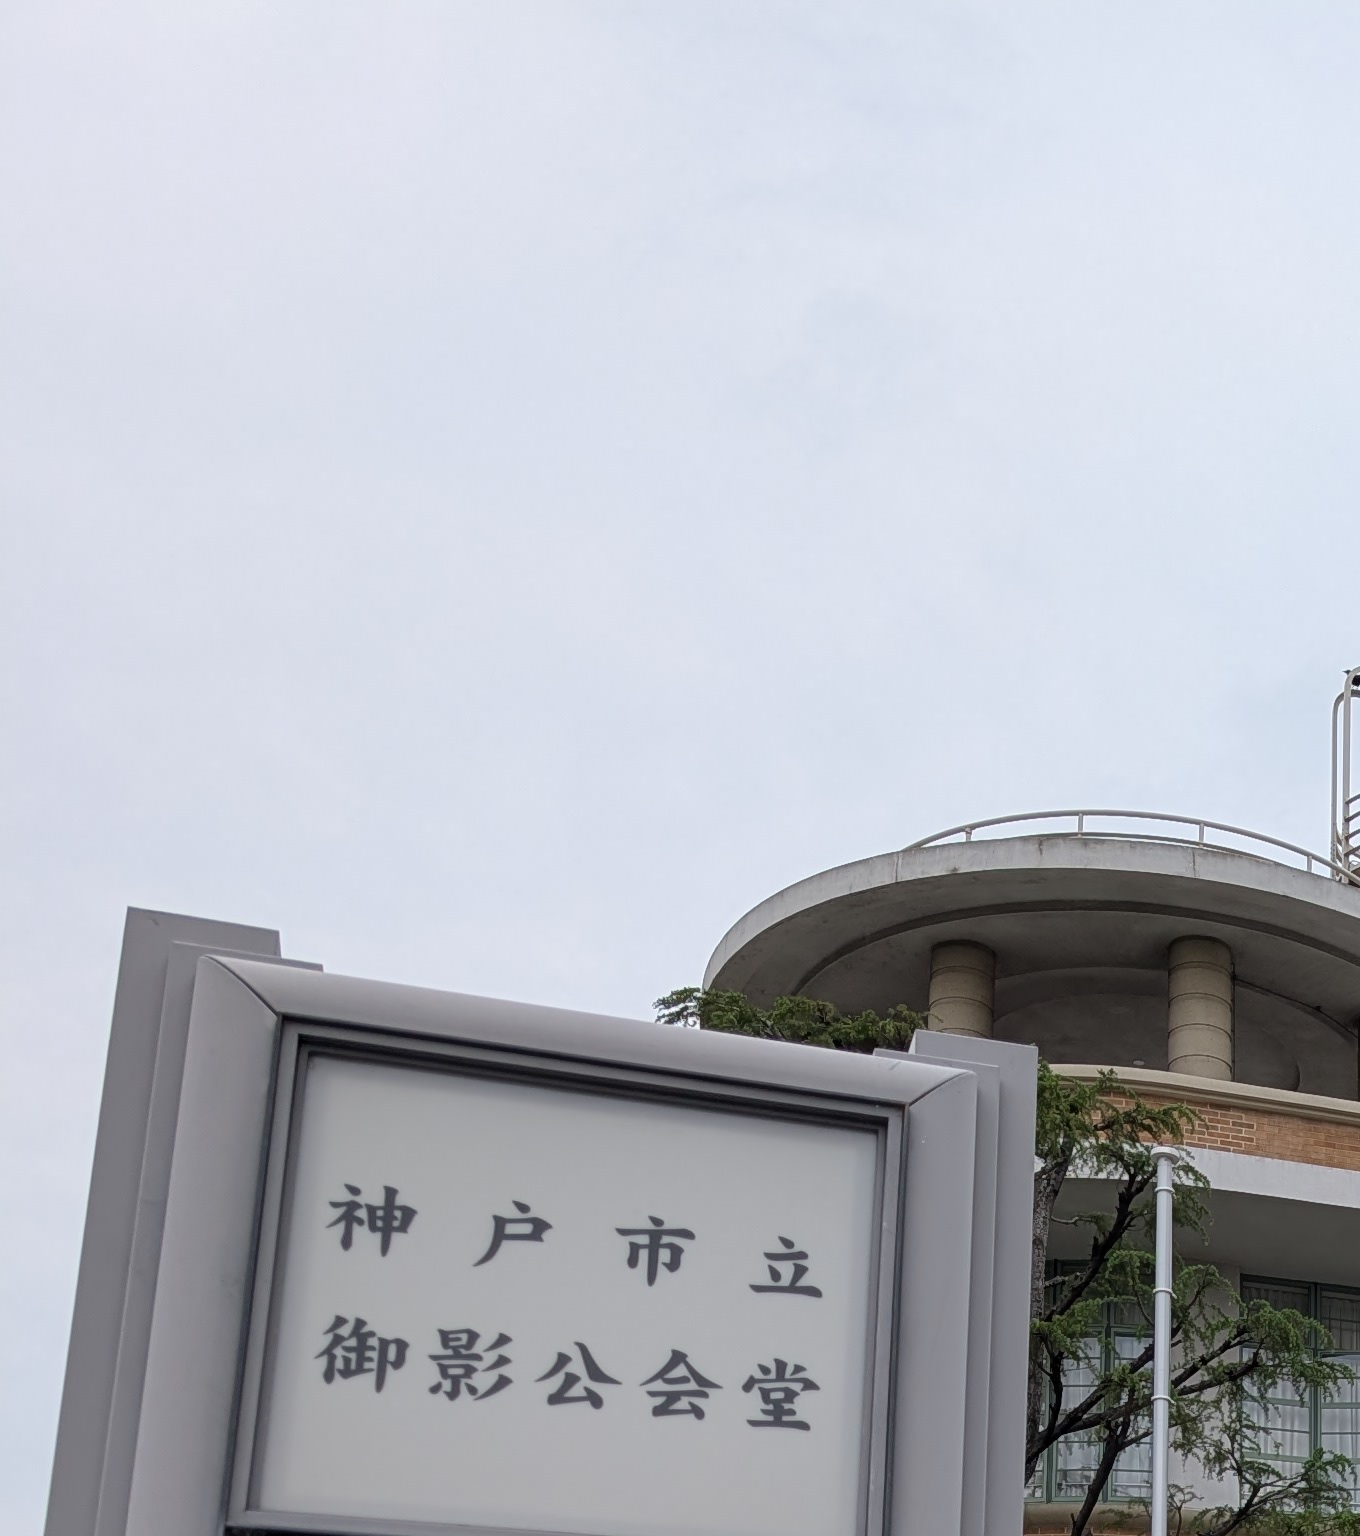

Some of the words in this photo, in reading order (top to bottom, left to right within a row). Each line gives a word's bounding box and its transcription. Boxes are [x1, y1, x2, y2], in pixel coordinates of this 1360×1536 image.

[327, 1184, 822, 1298] 神戸市立
[315, 1315, 820, 1431] 御影公会堂
